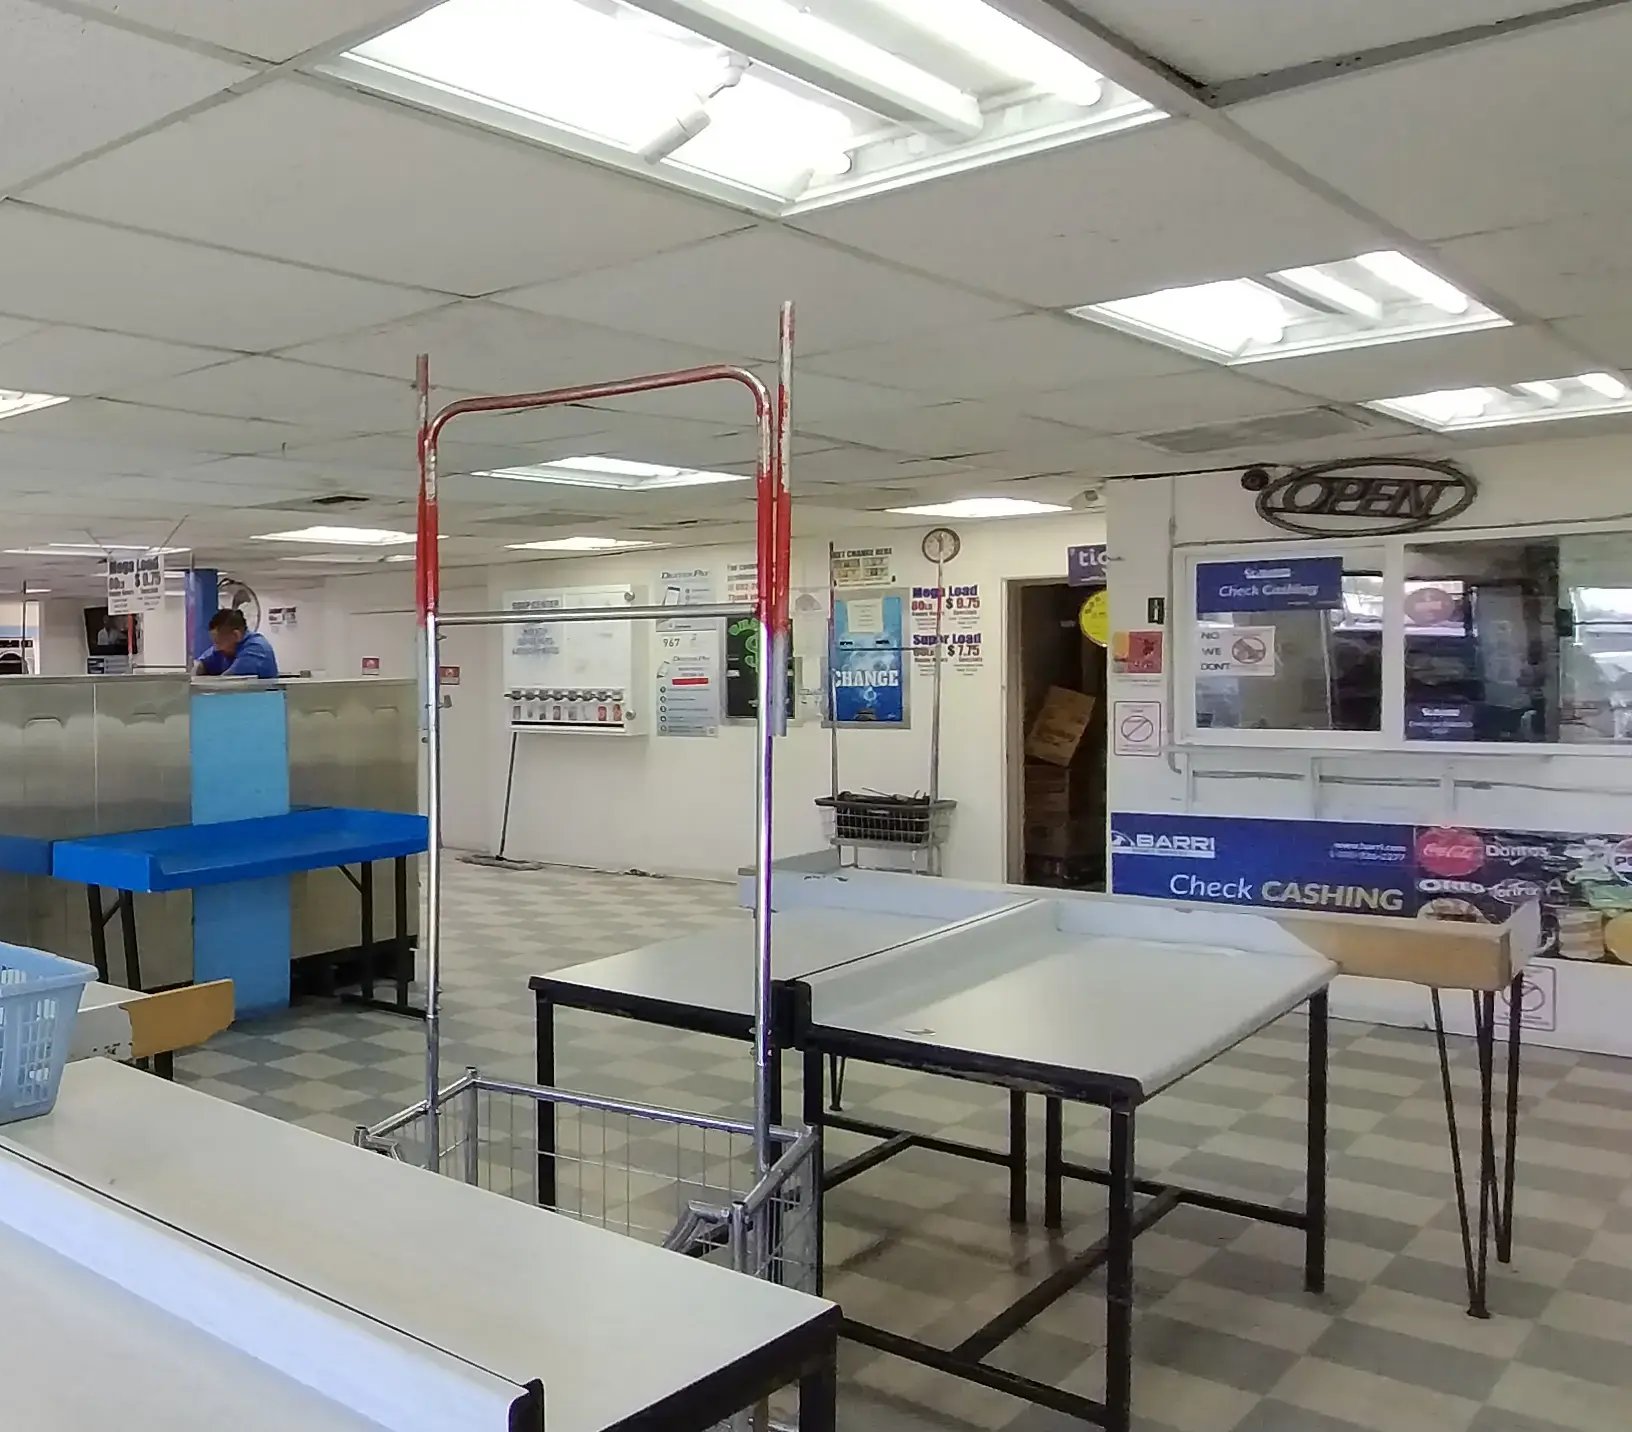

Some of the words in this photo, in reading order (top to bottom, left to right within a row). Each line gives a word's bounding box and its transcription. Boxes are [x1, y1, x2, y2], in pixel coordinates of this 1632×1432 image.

[1282, 477, 1446, 519] OPEN
[948, 585, 978, 597] Load
[1218, 585, 1260, 597] Check
[946, 597, 953, 609] $
[952, 632, 981, 645] Load
[1200, 631, 1219, 640] NO
[663, 638, 680, 647] 967
[948, 644, 955, 657] $
[958, 644, 980, 656] 7.75
[1202, 647, 1222, 656] WE
[834, 670, 899, 688] CHANGE
[1135, 834, 1216, 851] BARRI
[1169, 874, 1253, 900] Check
[1261, 880, 1405, 911] CASHING
